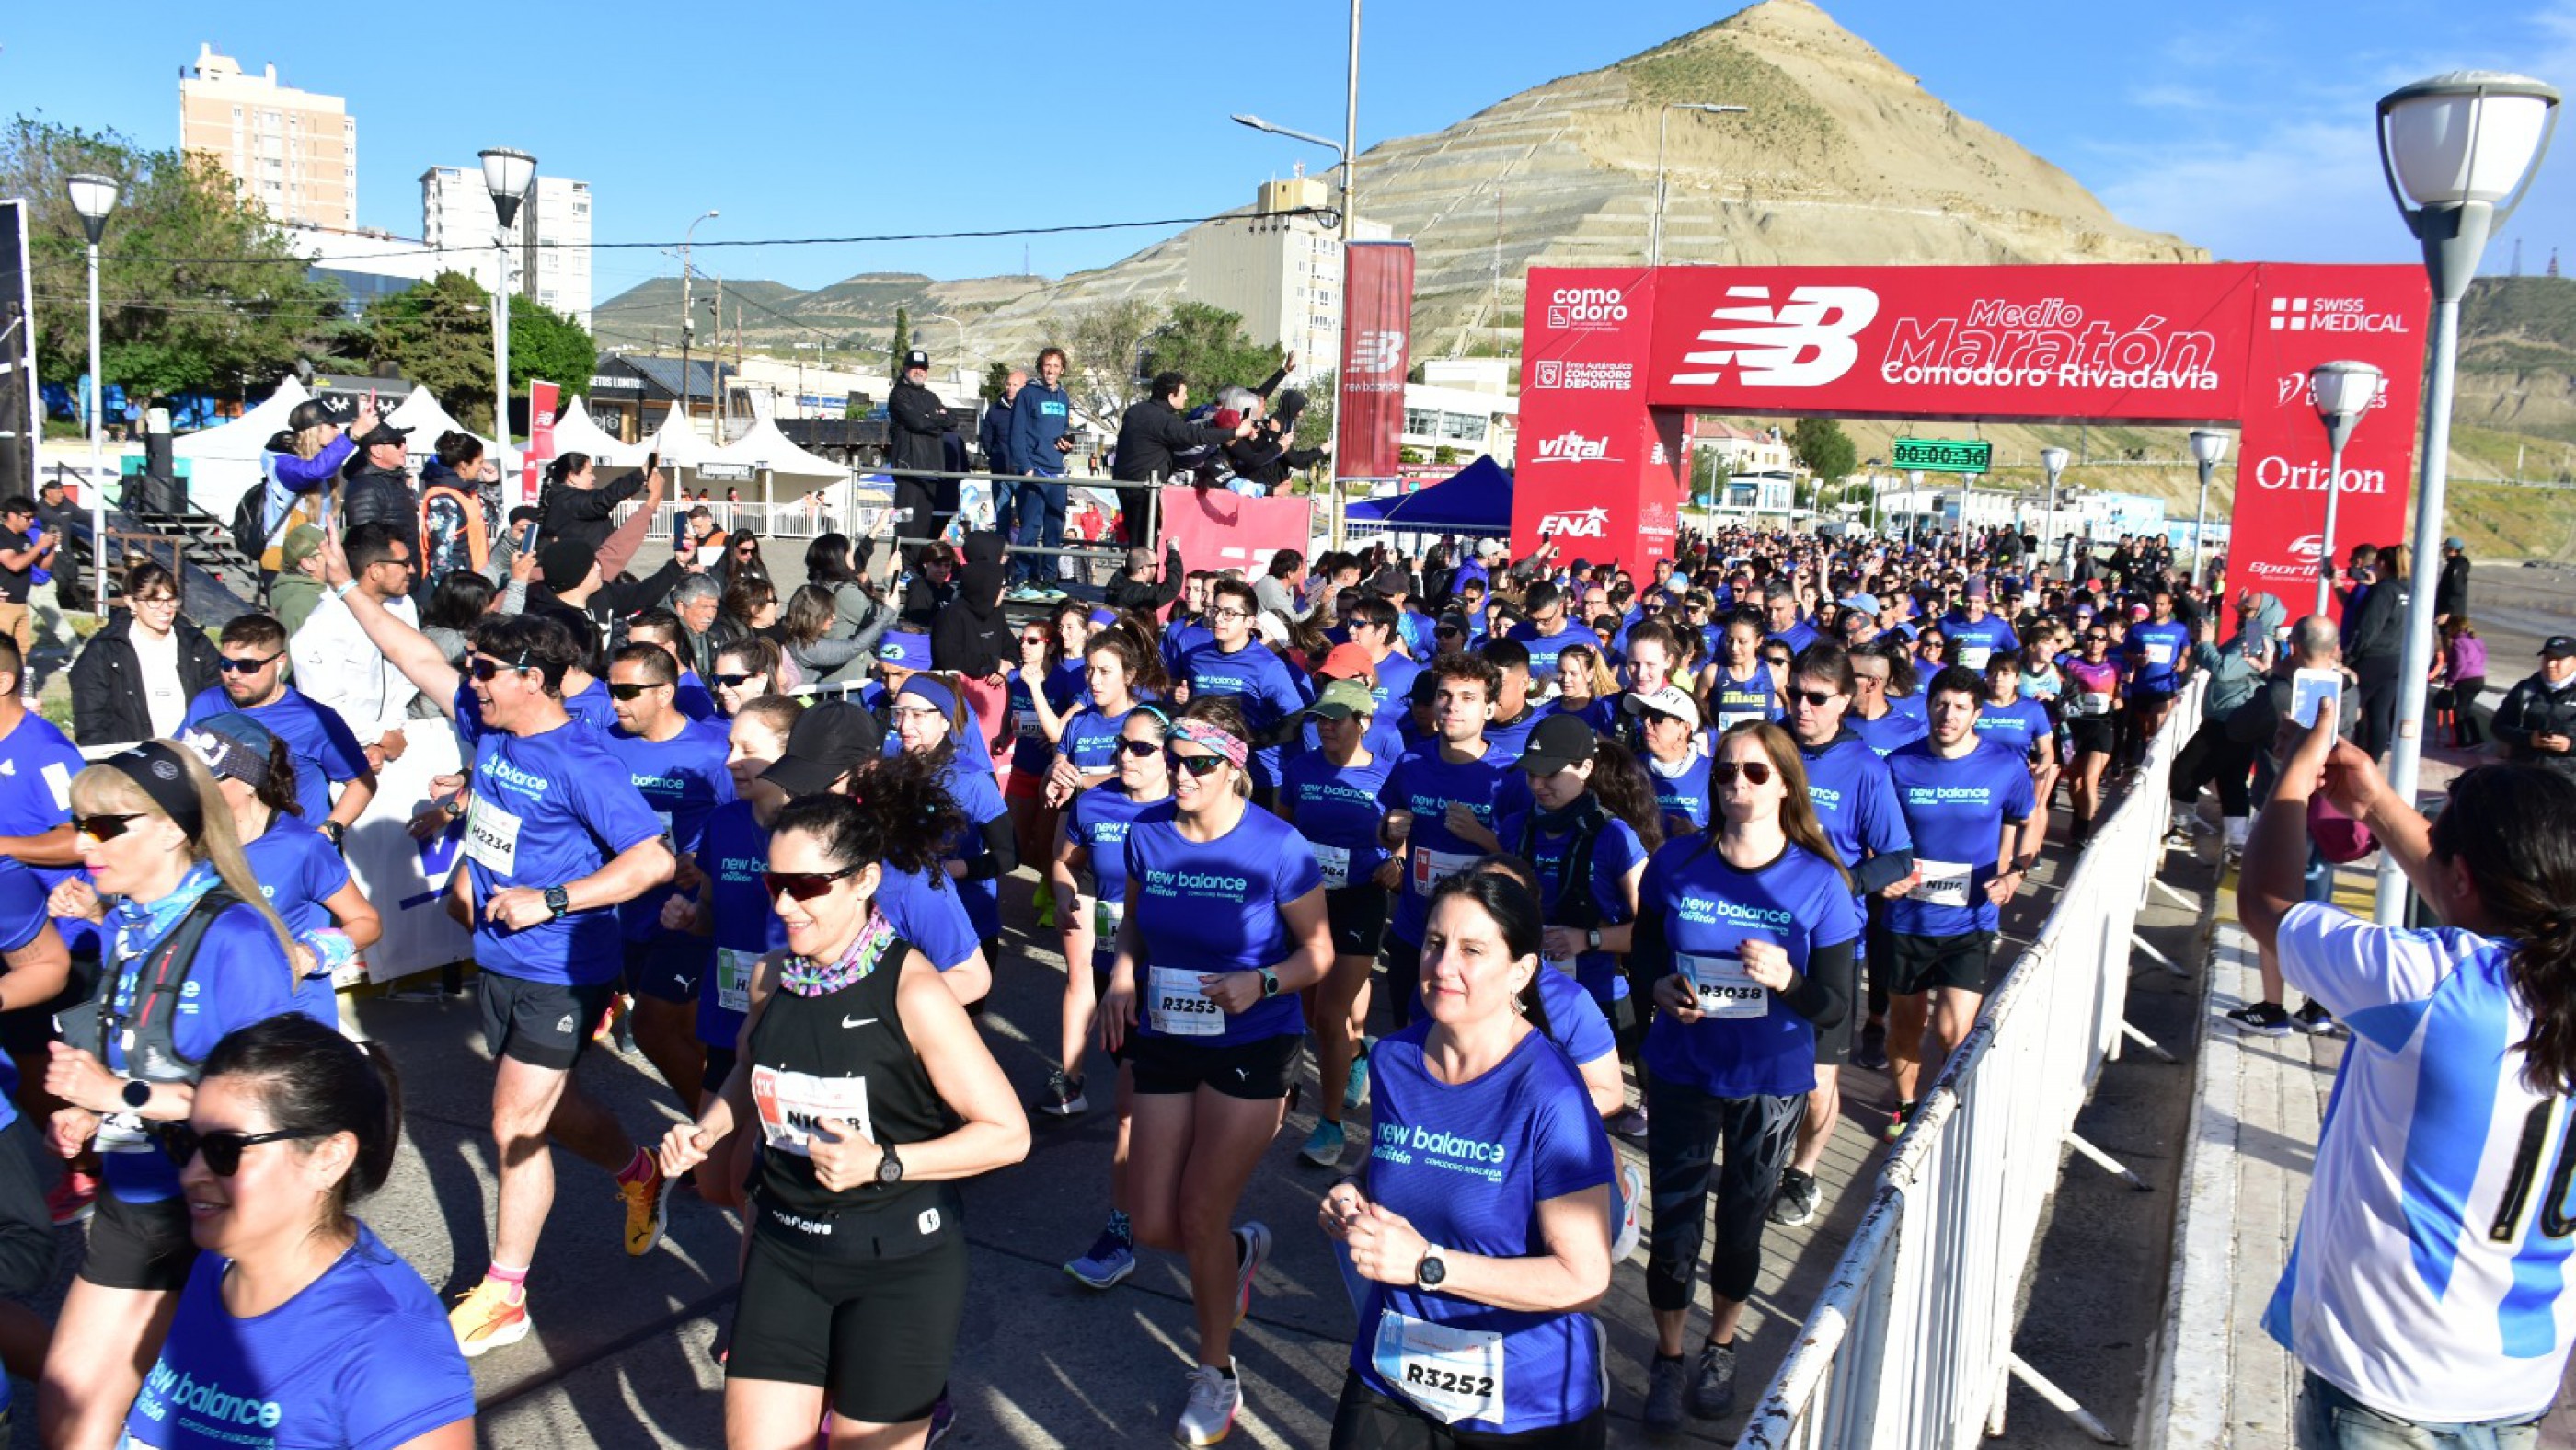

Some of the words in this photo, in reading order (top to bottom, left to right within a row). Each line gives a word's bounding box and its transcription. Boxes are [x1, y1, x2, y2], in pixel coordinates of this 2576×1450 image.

[1553, 287, 1621, 304] como
[1570, 304, 1628, 320] doro
[1968, 299, 2082, 328] Medio
[2313, 298, 2365, 312] SWISS
[2310, 314, 2409, 332] MEDICAL
[1882, 313, 2215, 377] Maratón
[1565, 369, 1632, 379] COMODORO
[1881, 362, 2047, 386] Comodoro
[2059, 364, 2218, 390] Rivadavia
[1344, 382, 1362, 393] new
[1564, 379, 1631, 390] DEPORTES
[1896, 446, 1984, 465] 00:00:36
[2256, 455, 2386, 494] Orizon
[1323, 785, 1374, 801] balance
[1937, 786, 1991, 799] balance
[471, 825, 512, 854] H2234
[721, 857, 749, 870] new
[1145, 869, 1177, 885] new
[1178, 870, 1248, 892] balance
[1681, 895, 1715, 913] new
[1717, 900, 1792, 924] balance
[1699, 984, 1763, 999] R3038
[1162, 996, 1216, 1014] R3253
[1378, 1122, 1411, 1145] new
[1411, 1125, 1506, 1164] balance
[1406, 1362, 1495, 1398] R3252
[170, 1372, 282, 1429] balance
